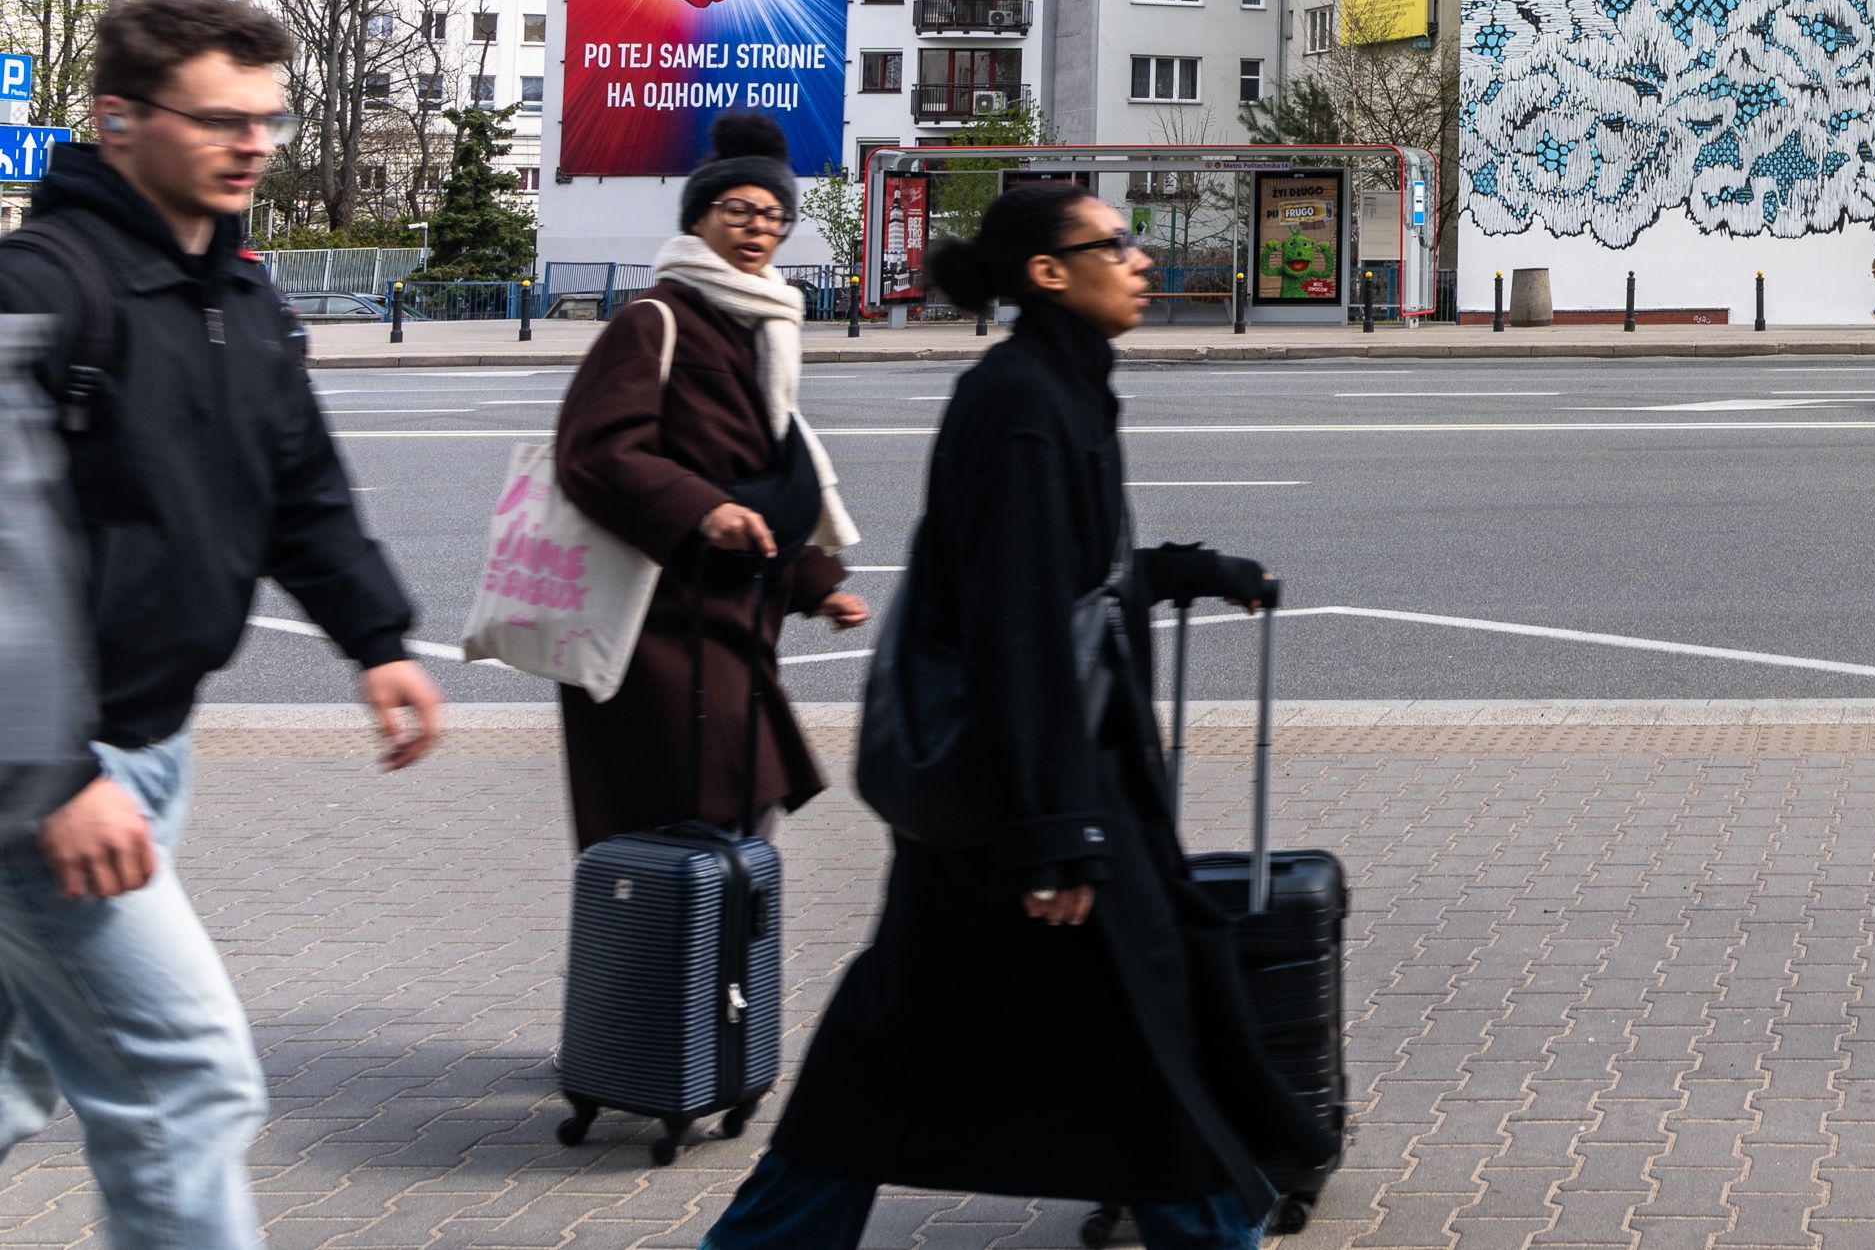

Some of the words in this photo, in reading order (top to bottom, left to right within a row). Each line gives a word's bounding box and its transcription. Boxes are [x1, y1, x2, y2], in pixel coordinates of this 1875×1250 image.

[584, 43, 611, 68] PO
[617, 43, 653, 68] TEJ
[659, 43, 729, 69] SAMEJ
[736, 43, 826, 69] STRONIE
[3, 59, 24, 94] P
[606, 82, 636, 108] НА
[643, 82, 740, 111] ОДНОМУ
[746, 82, 799, 112] БОЦІ
[1289, 186, 1324, 197] DŁUGO
[1285, 207, 1314, 218] FRUGO
